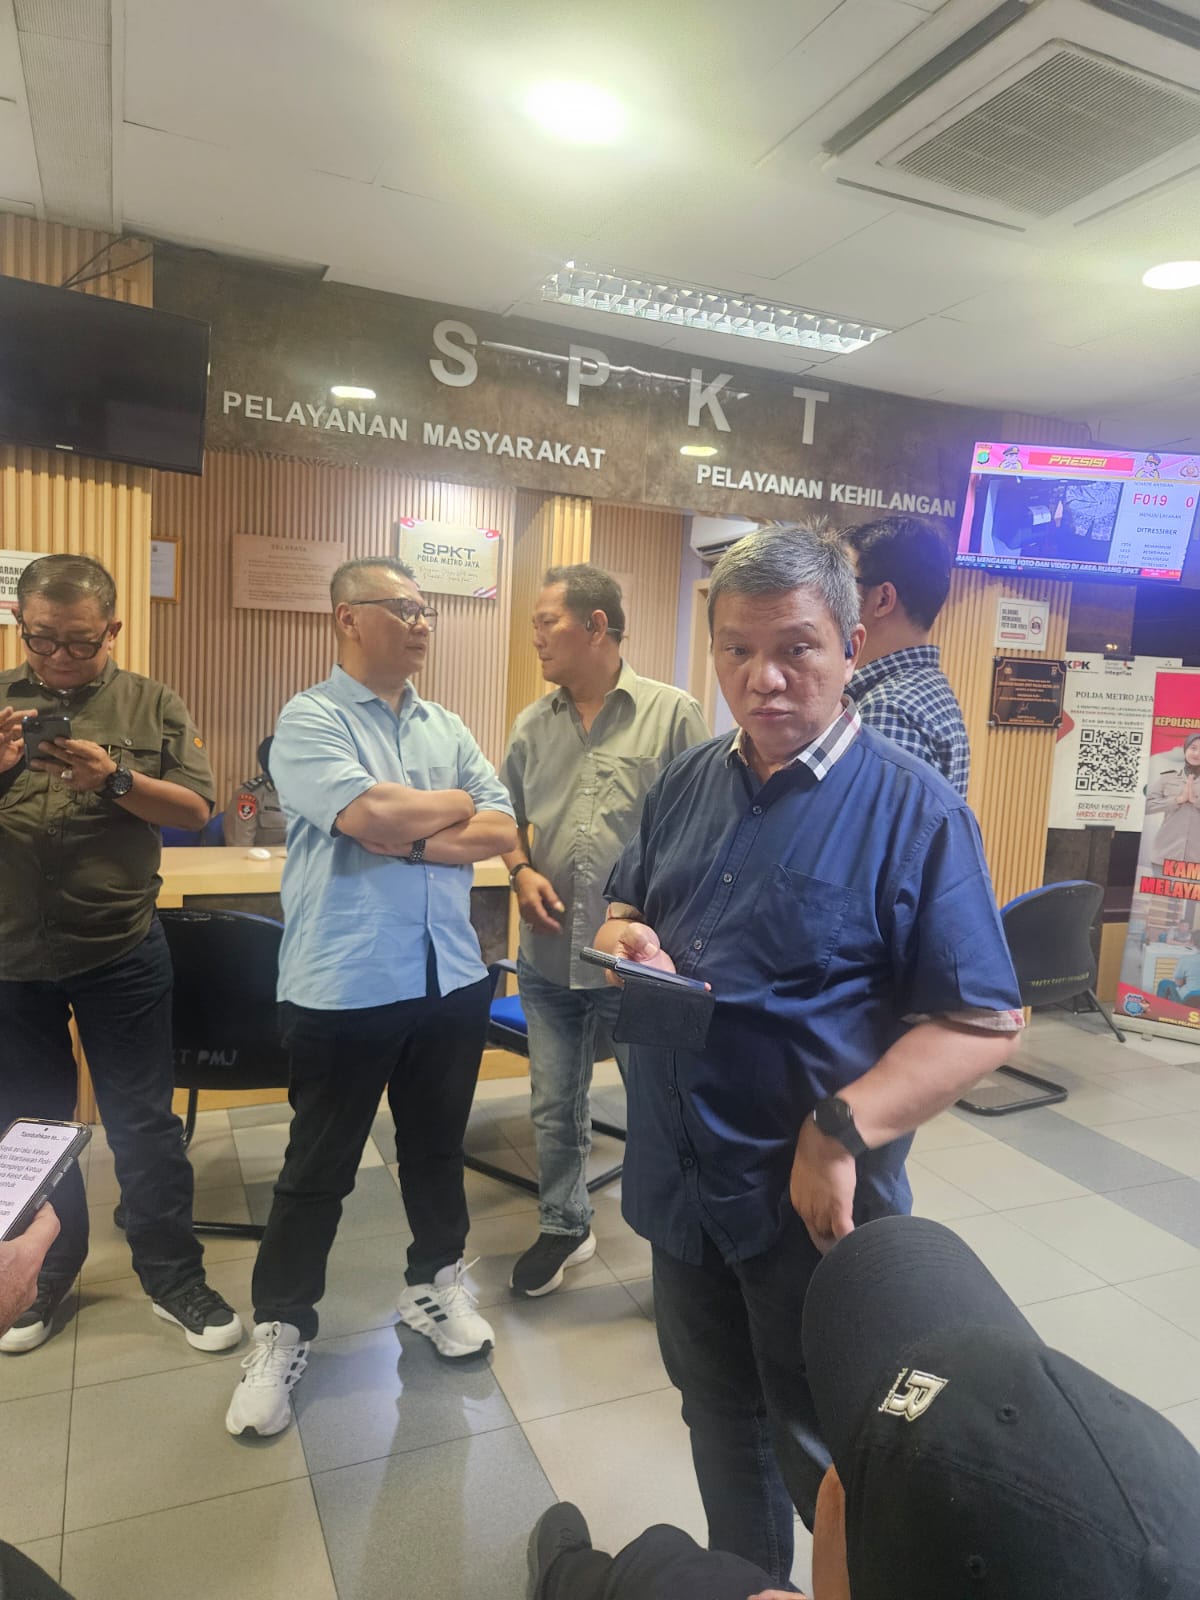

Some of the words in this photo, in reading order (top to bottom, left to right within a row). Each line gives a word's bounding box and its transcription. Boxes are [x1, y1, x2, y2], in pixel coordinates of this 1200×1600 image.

[429, 319, 479, 387] S
[565, 344, 611, 407] P
[687, 367, 734, 433] K
[792, 386, 830, 445] T
[223, 390, 408, 441] PELAYANAN
[423, 422, 606, 470] MASYARAKAT
[1048, 454, 1107, 468] PRESISI
[696, 464, 823, 500] PELAYANAN
[830, 483, 956, 518] KEHILANGAN
[1133, 493, 1168, 507] F019
[422, 542, 476, 561] SPKT
[417, 554, 439, 564] POLDA
[440, 558, 463, 567] METRO
[464, 560, 480, 568] JAYA
[1017, 559, 1034, 567] FOTO
[1035, 560, 1050, 568] DAN
[1051, 561, 1071, 570] VIDEO
[1064, 660, 1091, 670] KPK
[1075, 690, 1103, 699] POLDA
[1105, 692, 1134, 701] METRO
[1135, 694, 1154, 703] JAYA
[197, 1048, 239, 1066] PMJ
